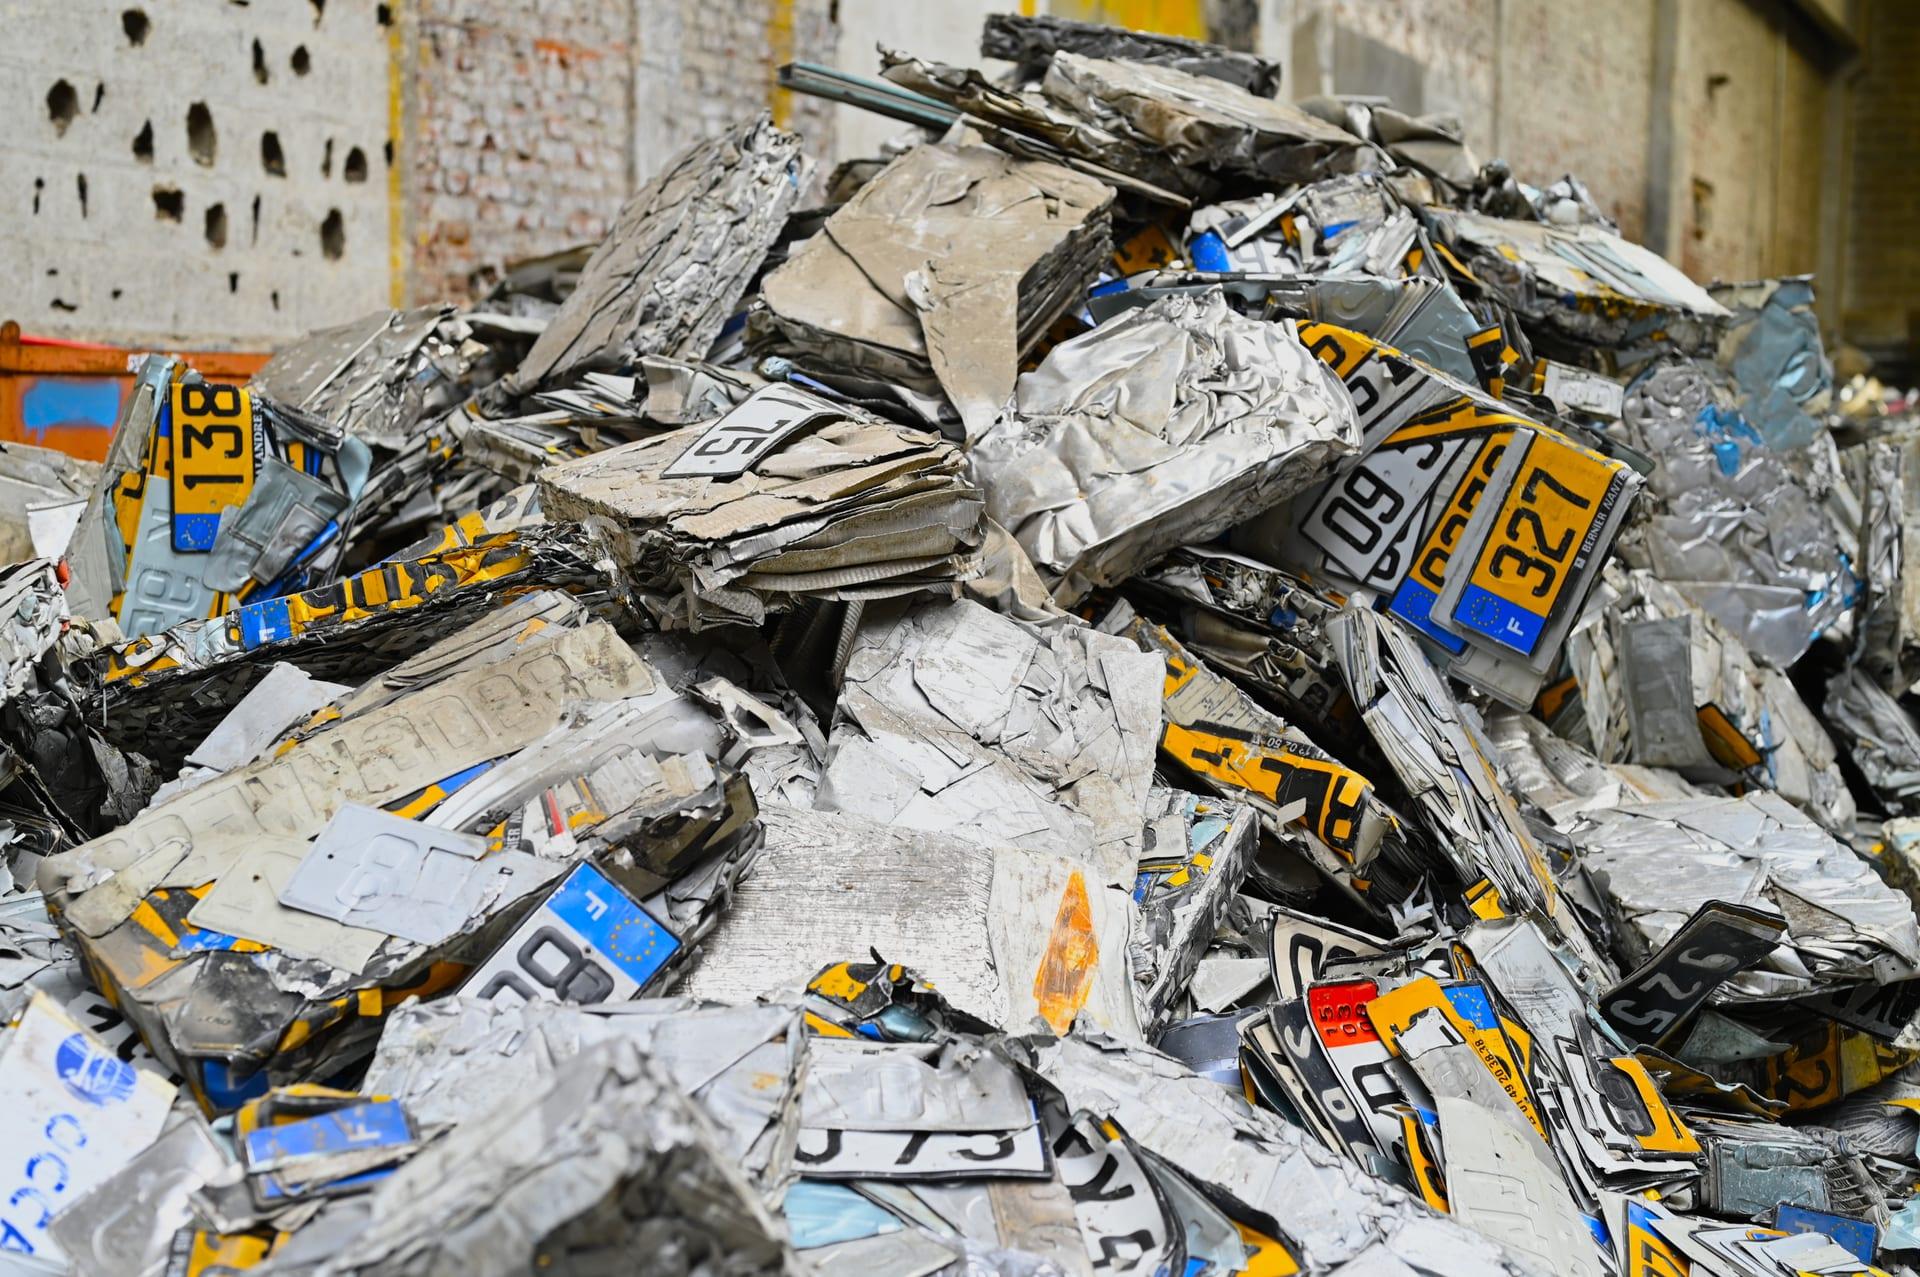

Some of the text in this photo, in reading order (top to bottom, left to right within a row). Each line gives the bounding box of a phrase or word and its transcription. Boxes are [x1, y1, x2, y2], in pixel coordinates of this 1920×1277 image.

[181, 383, 244, 491] 138
[694, 418, 793, 458] 75
[1322, 466, 1404, 555] 09
[1580, 469, 1632, 555] BERNIER NANTE
[1488, 467, 1591, 598] 327
[1507, 616, 1524, 637] F
[1266, 736, 1283, 750] 50
[584, 889, 609, 921] F
[1494, 1067, 1510, 1084] 20
